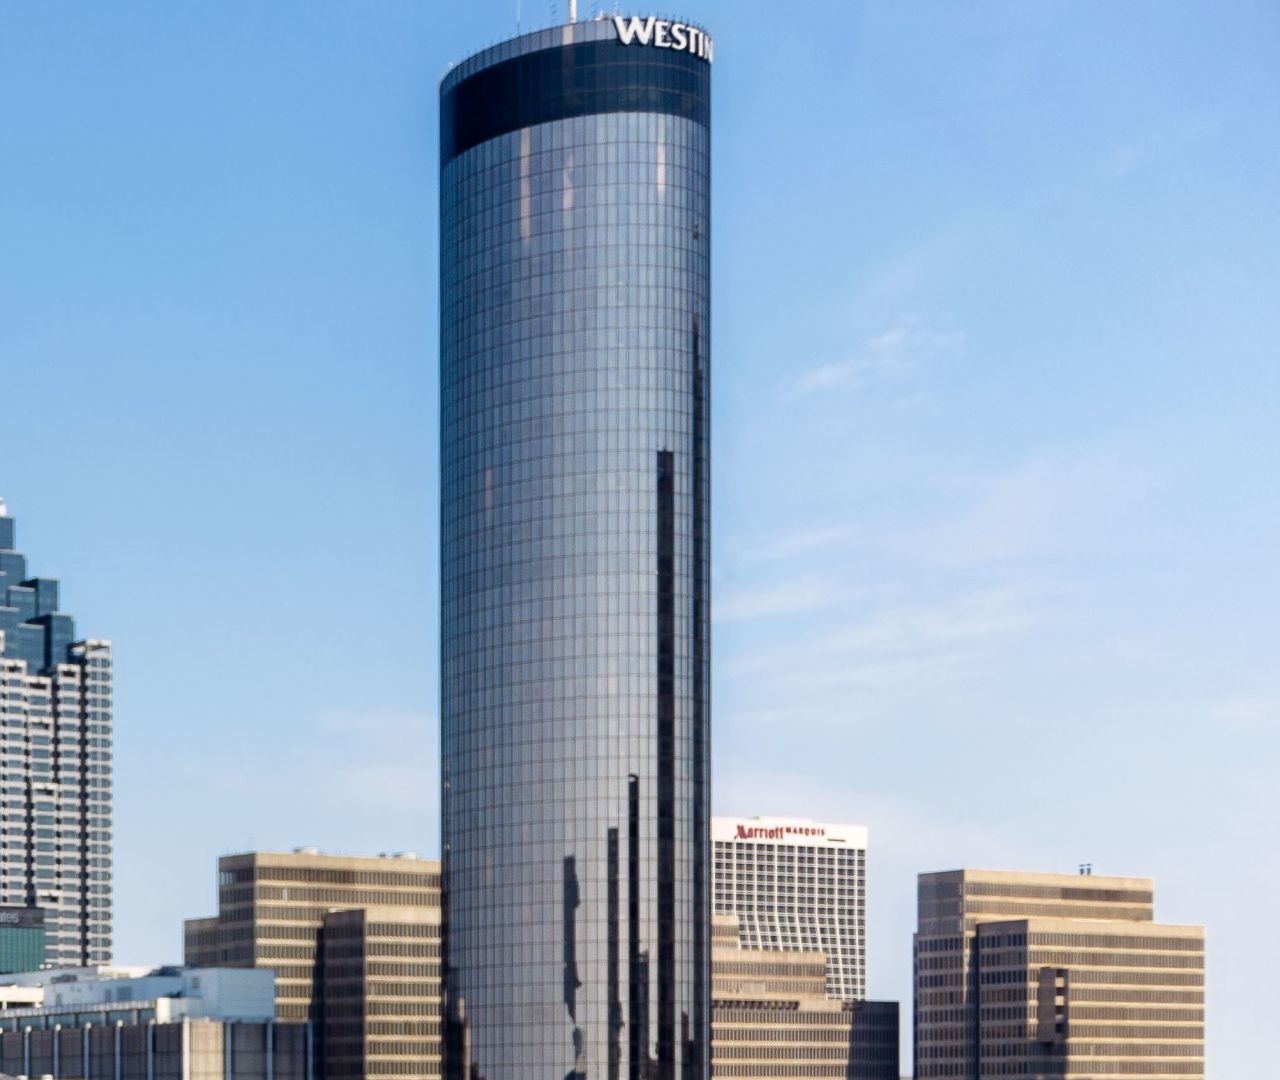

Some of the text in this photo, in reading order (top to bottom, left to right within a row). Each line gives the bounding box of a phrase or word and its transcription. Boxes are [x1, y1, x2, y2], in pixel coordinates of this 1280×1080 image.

[614, 15, 714, 64] WESTIN
[734, 824, 825, 839] Marriott MARQUIS
